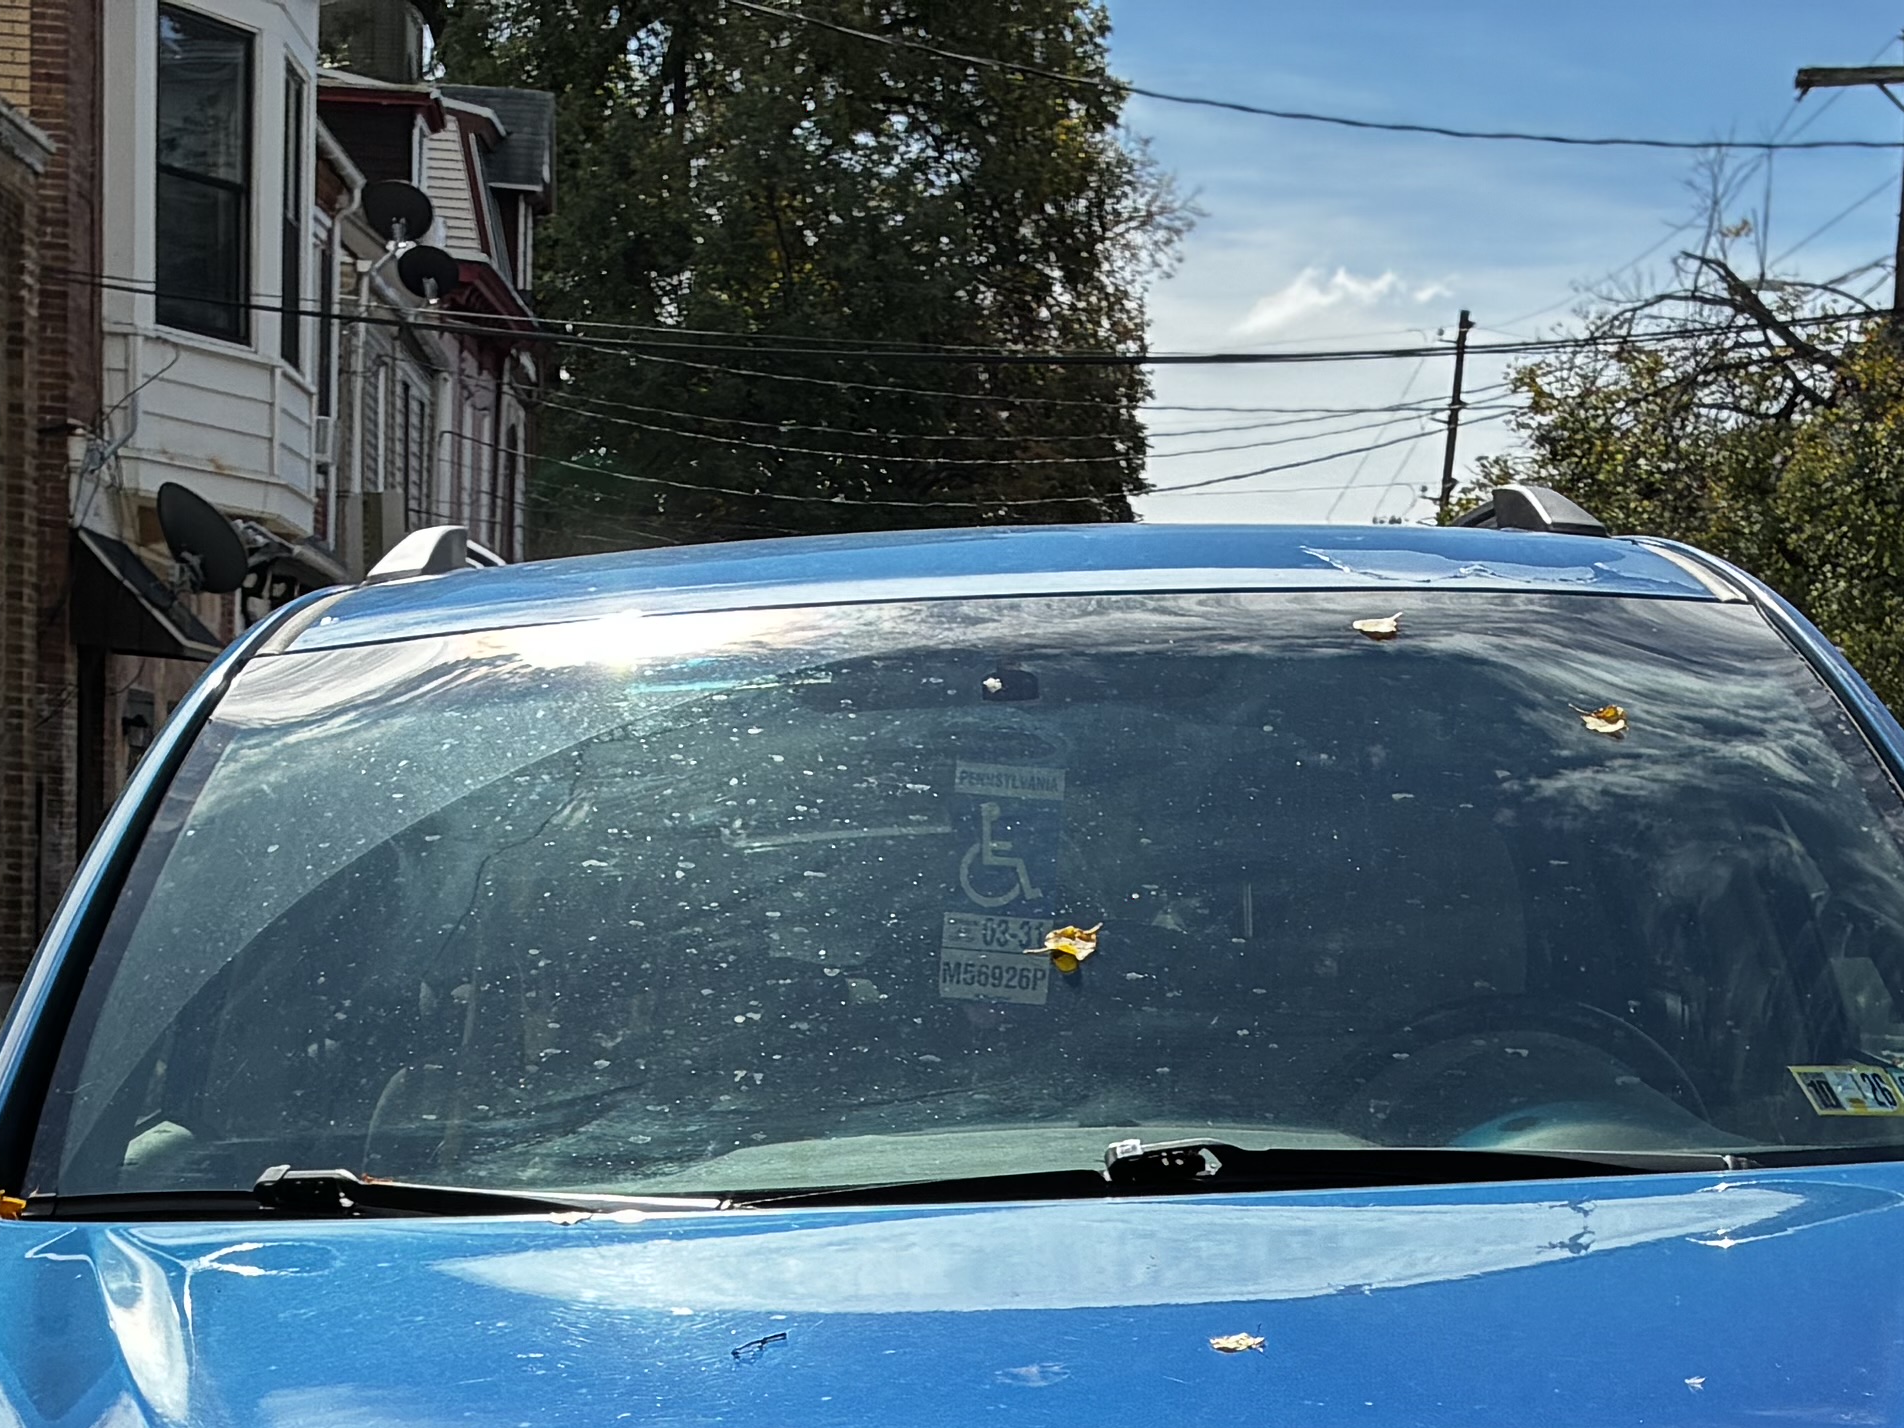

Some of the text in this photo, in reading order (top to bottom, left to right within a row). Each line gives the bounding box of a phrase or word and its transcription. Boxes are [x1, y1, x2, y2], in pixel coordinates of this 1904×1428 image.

[959, 769, 1059, 793] PENNSYLVANIA
[942, 961, 1047, 991] M56926P
[1859, 1072, 1898, 1109] 26
